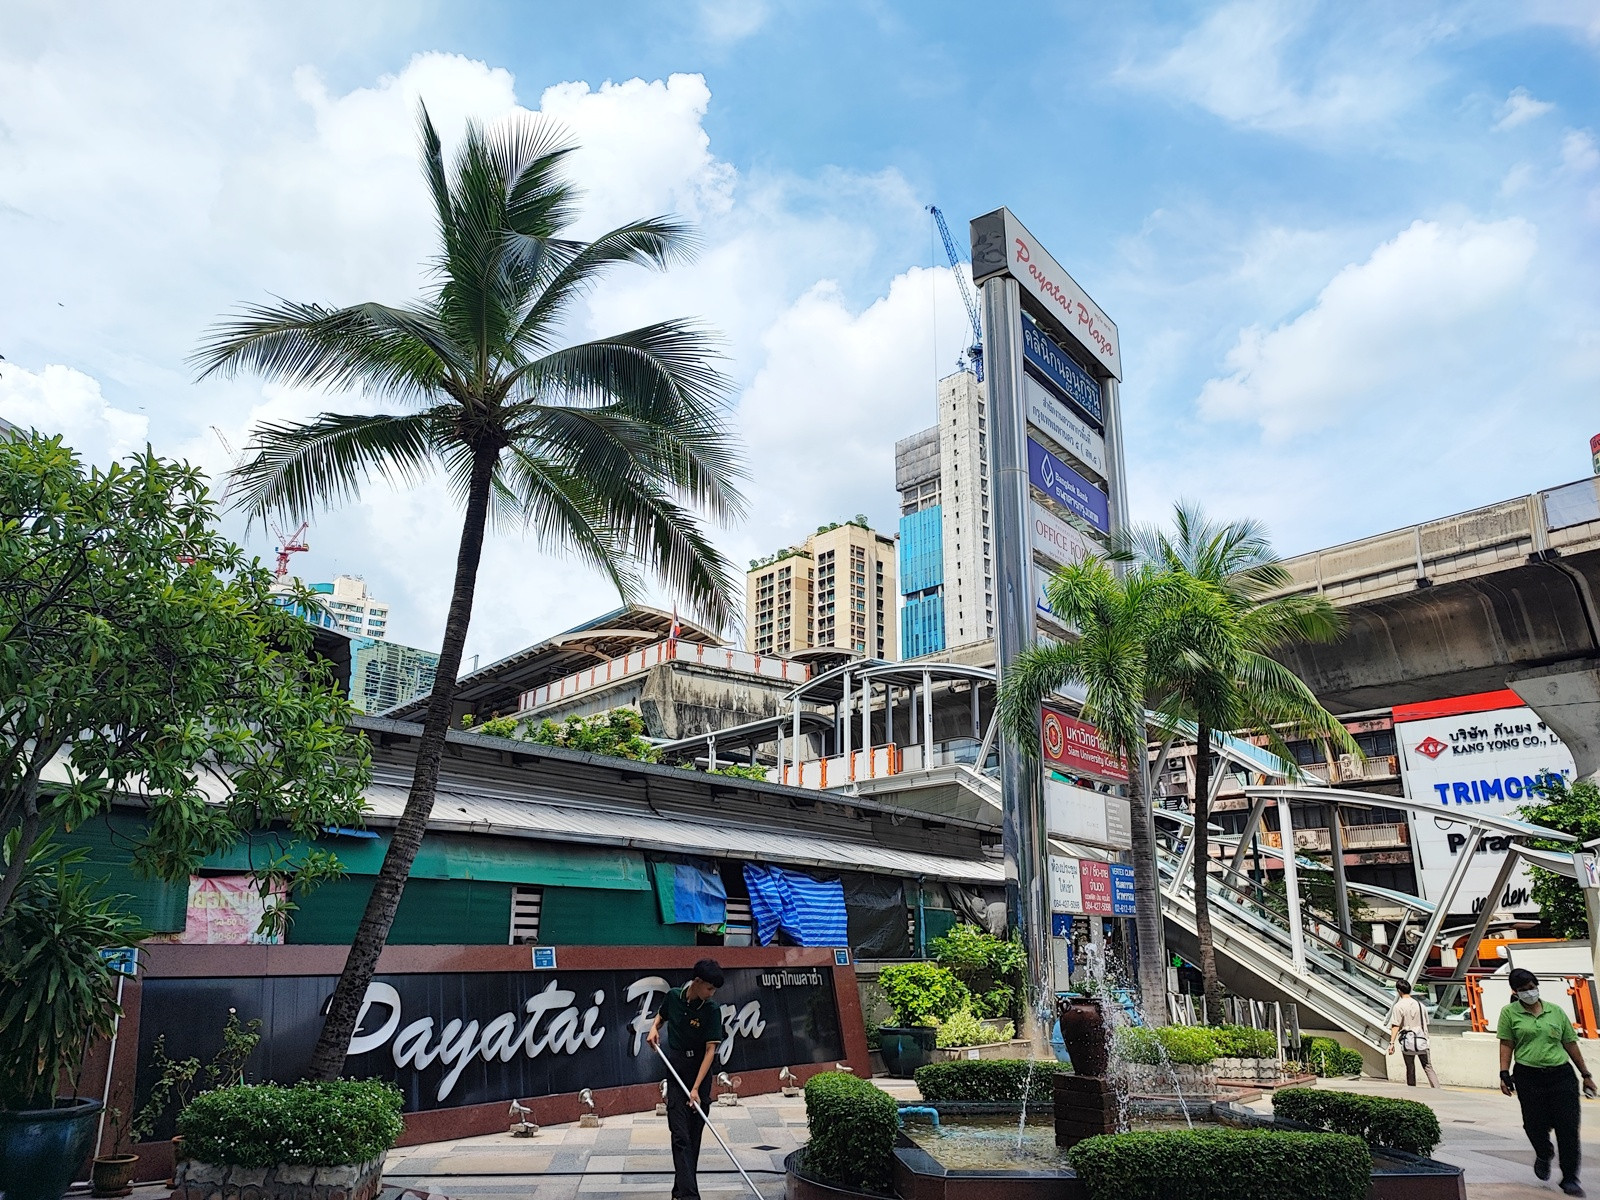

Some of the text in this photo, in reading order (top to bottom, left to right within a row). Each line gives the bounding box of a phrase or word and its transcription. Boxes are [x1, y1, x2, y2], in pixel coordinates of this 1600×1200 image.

[1015, 238, 1072, 314] Payatai
[1076, 302, 1113, 356] Plaza
[1055, 471, 1089, 503] Bangkok Bank
[1035, 519, 1068, 551] OFFICE
[1449, 726, 1488, 742] บริษัท
[1494, 722, 1532, 737] กันยง
[1452, 742, 1484, 755] KANG
[1487, 738, 1519, 751] YONG
[1522, 735, 1547, 748] CO.,
[1067, 745, 1080, 758] Siam
[1080, 749, 1104, 767] University
[761, 967, 823, 989] พญาไทพลาซ่า
[322, 974, 767, 1103] Payatai Pza
